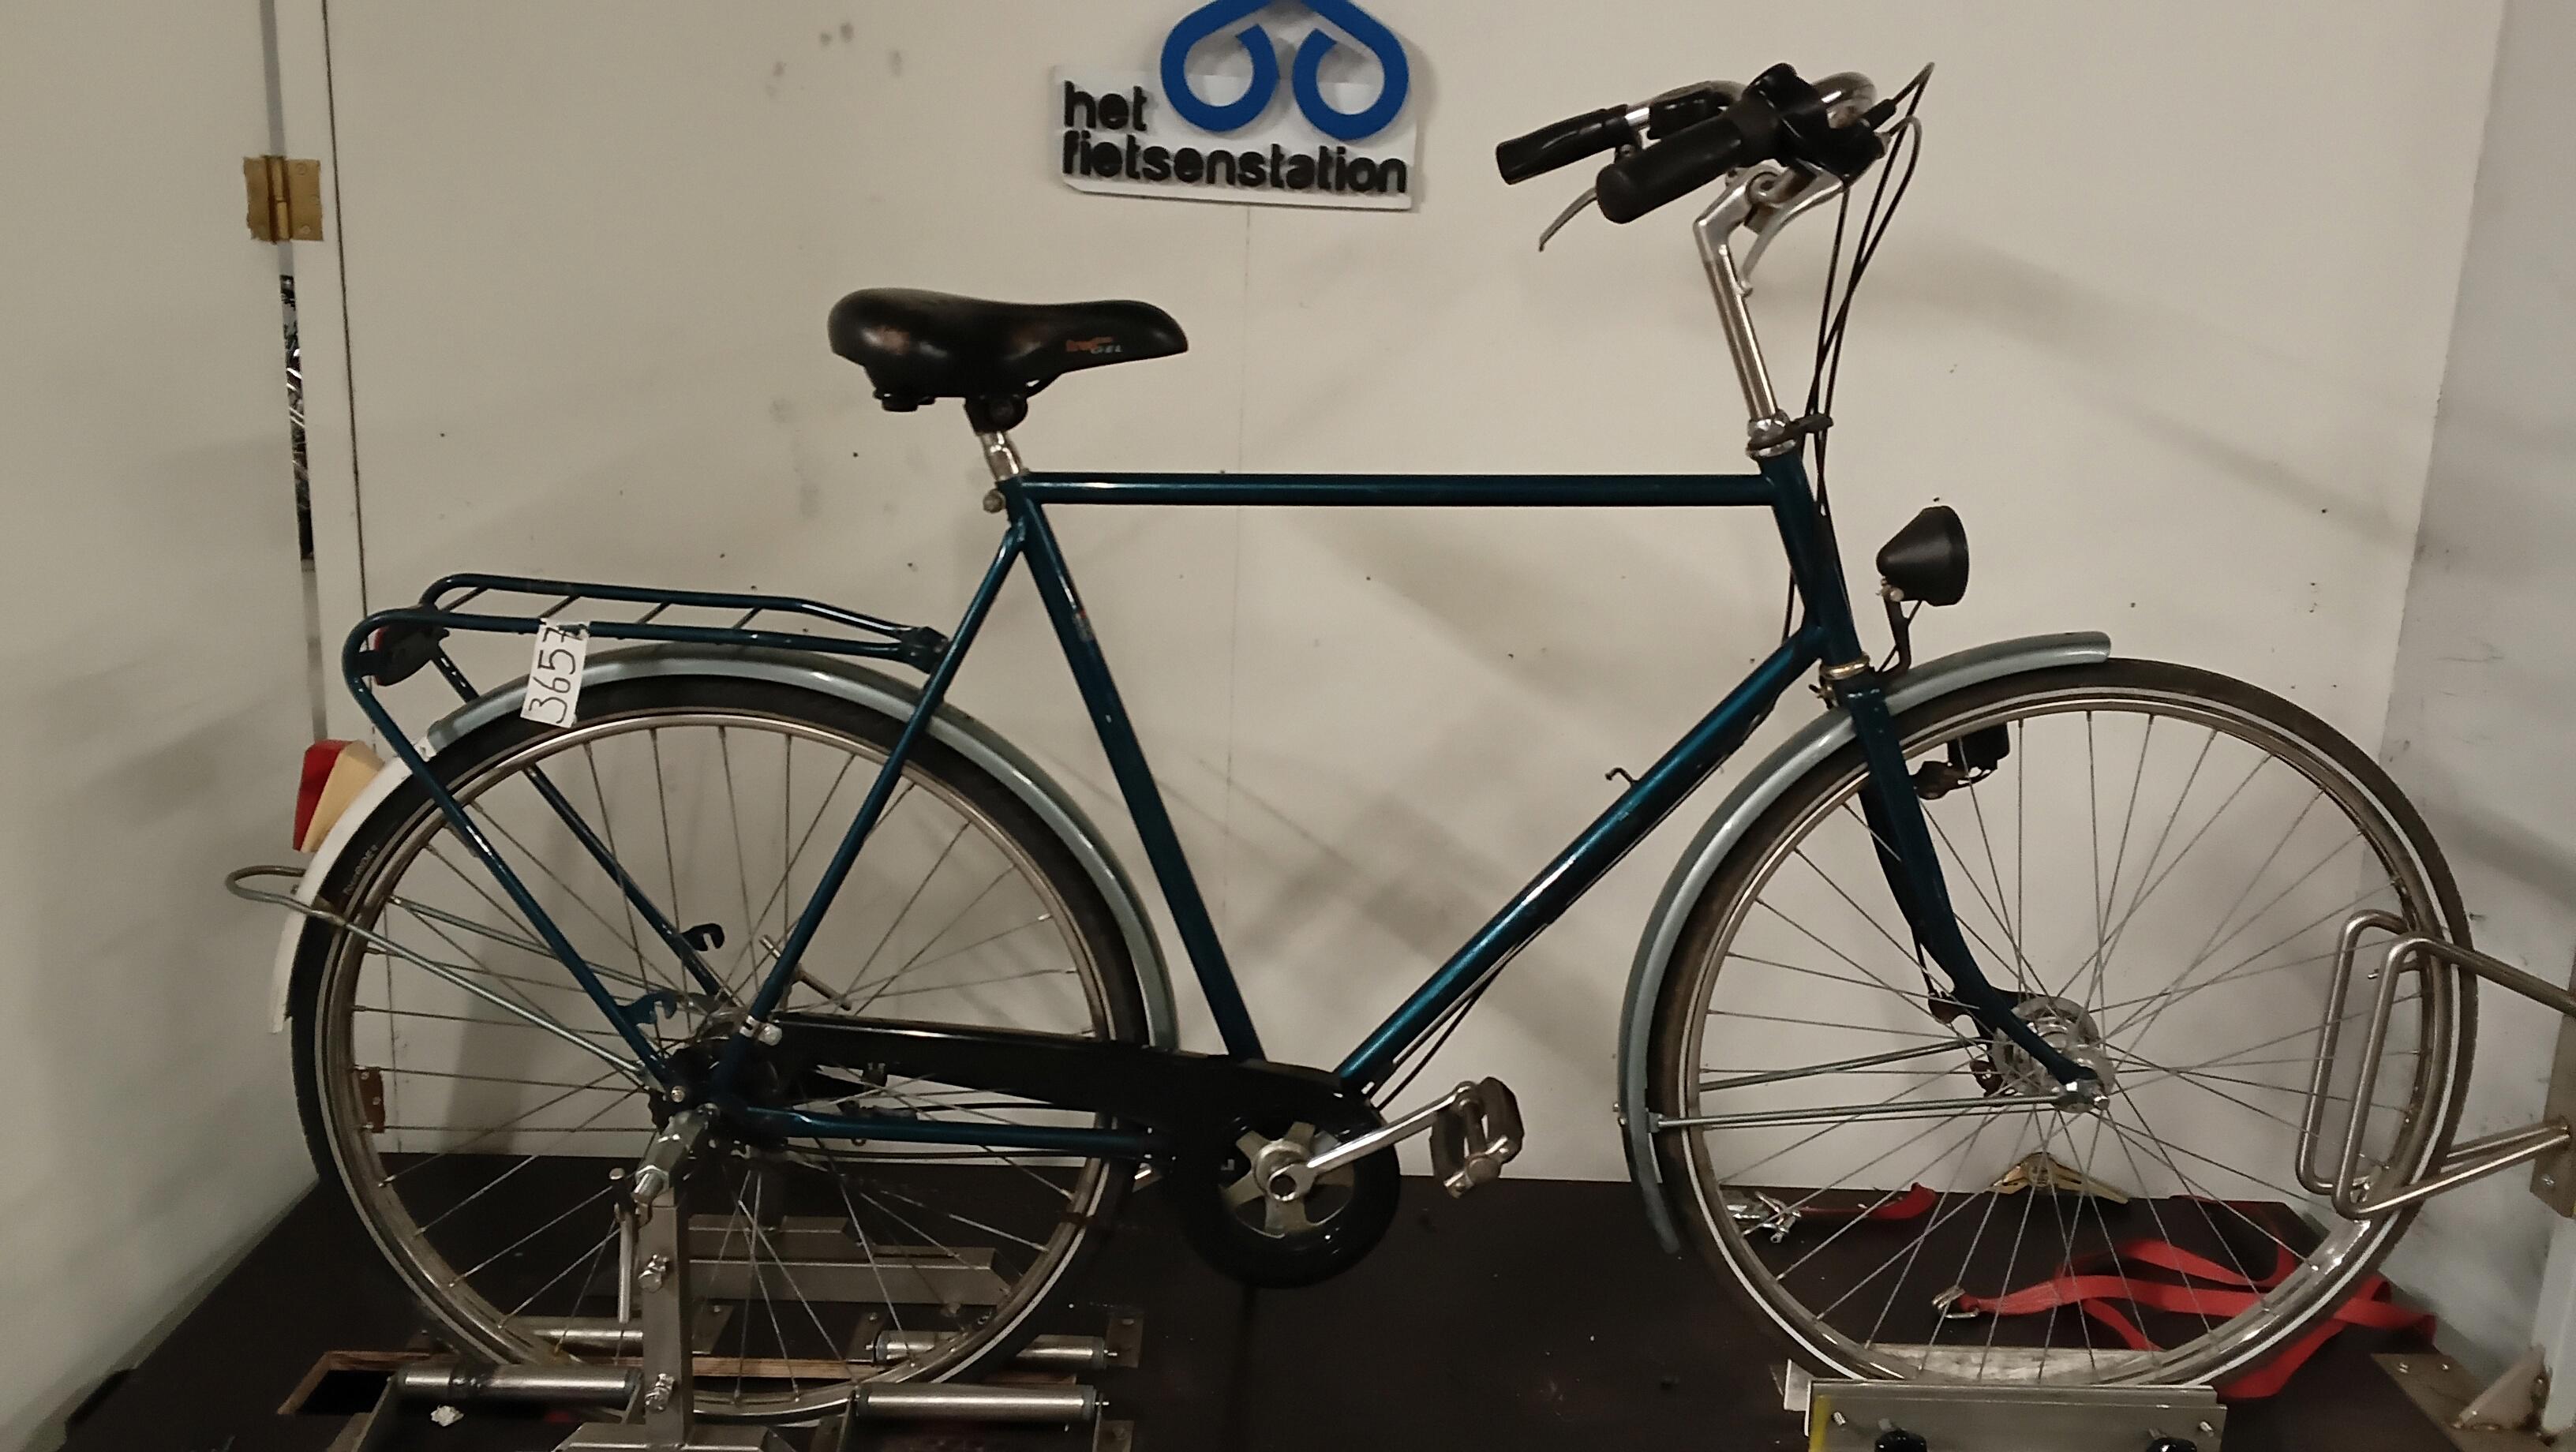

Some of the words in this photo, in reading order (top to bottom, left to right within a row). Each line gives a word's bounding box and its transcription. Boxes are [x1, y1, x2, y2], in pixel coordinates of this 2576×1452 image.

[1064, 80, 1147, 131] het
[1062, 129, 1407, 193] fietsenstation
[528, 627, 583, 724] 3657
